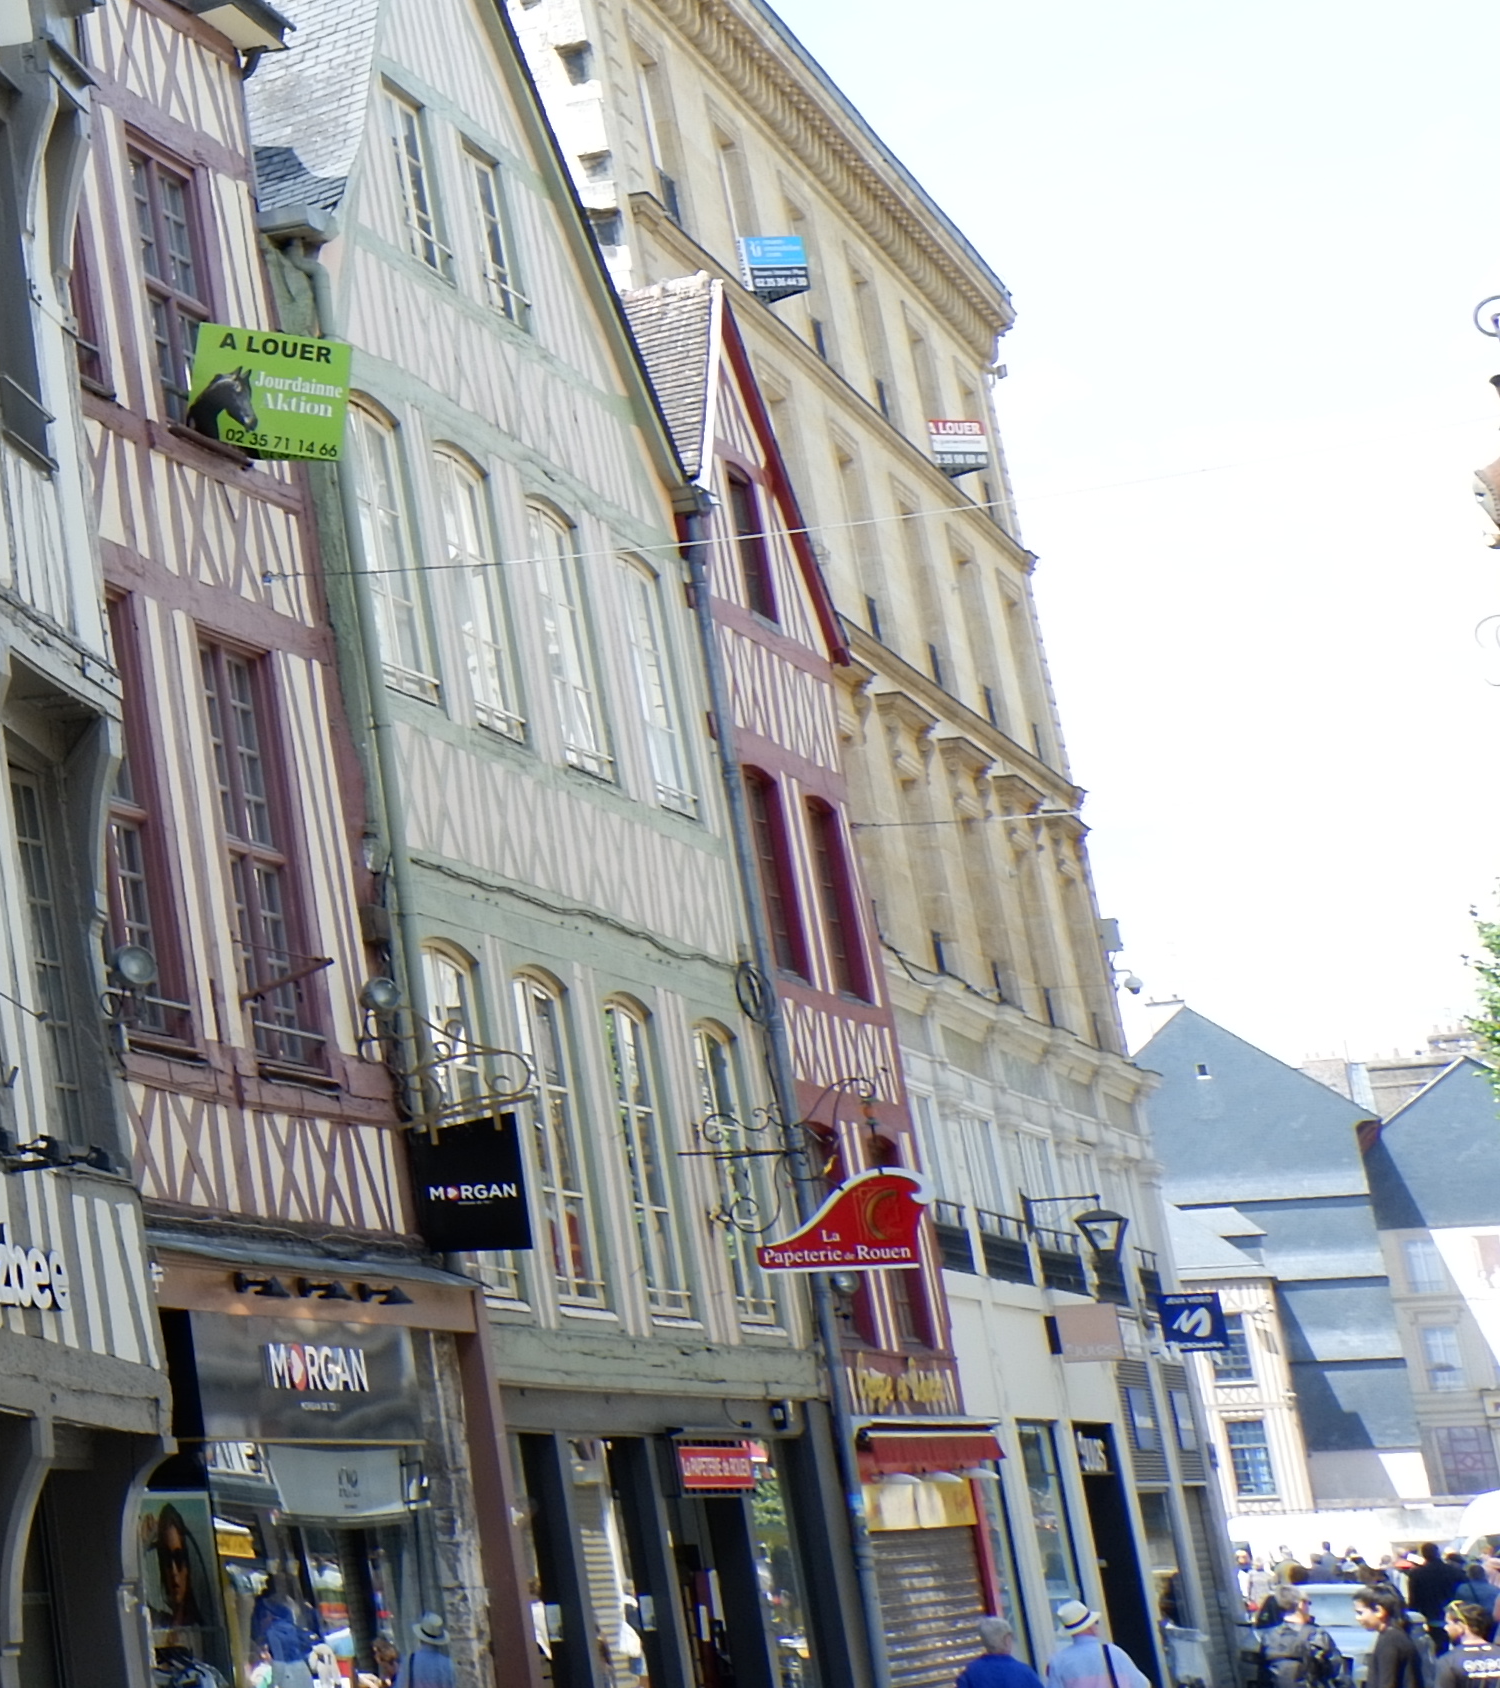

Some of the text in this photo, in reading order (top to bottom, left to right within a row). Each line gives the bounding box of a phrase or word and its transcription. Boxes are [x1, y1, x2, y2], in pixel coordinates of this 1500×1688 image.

[219, 332, 332, 365] A LOUER
[255, 370, 343, 399] Jourdainne
[262, 391, 333, 418] Aktion
[938, 422, 982, 434] LOUER
[225, 428, 244, 444] 02
[249, 431, 268, 447] 35
[274, 435, 290, 451] 71
[298, 439, 315, 455] 14
[319, 443, 338, 458] 66
[428, 1183, 518, 1202] MORGAN
[821, 1229, 841, 1243] La
[764, 1246, 842, 1267] Papeterie
[856, 1244, 912, 1261] Rouen
[268, 1343, 369, 1392] MORGAN
